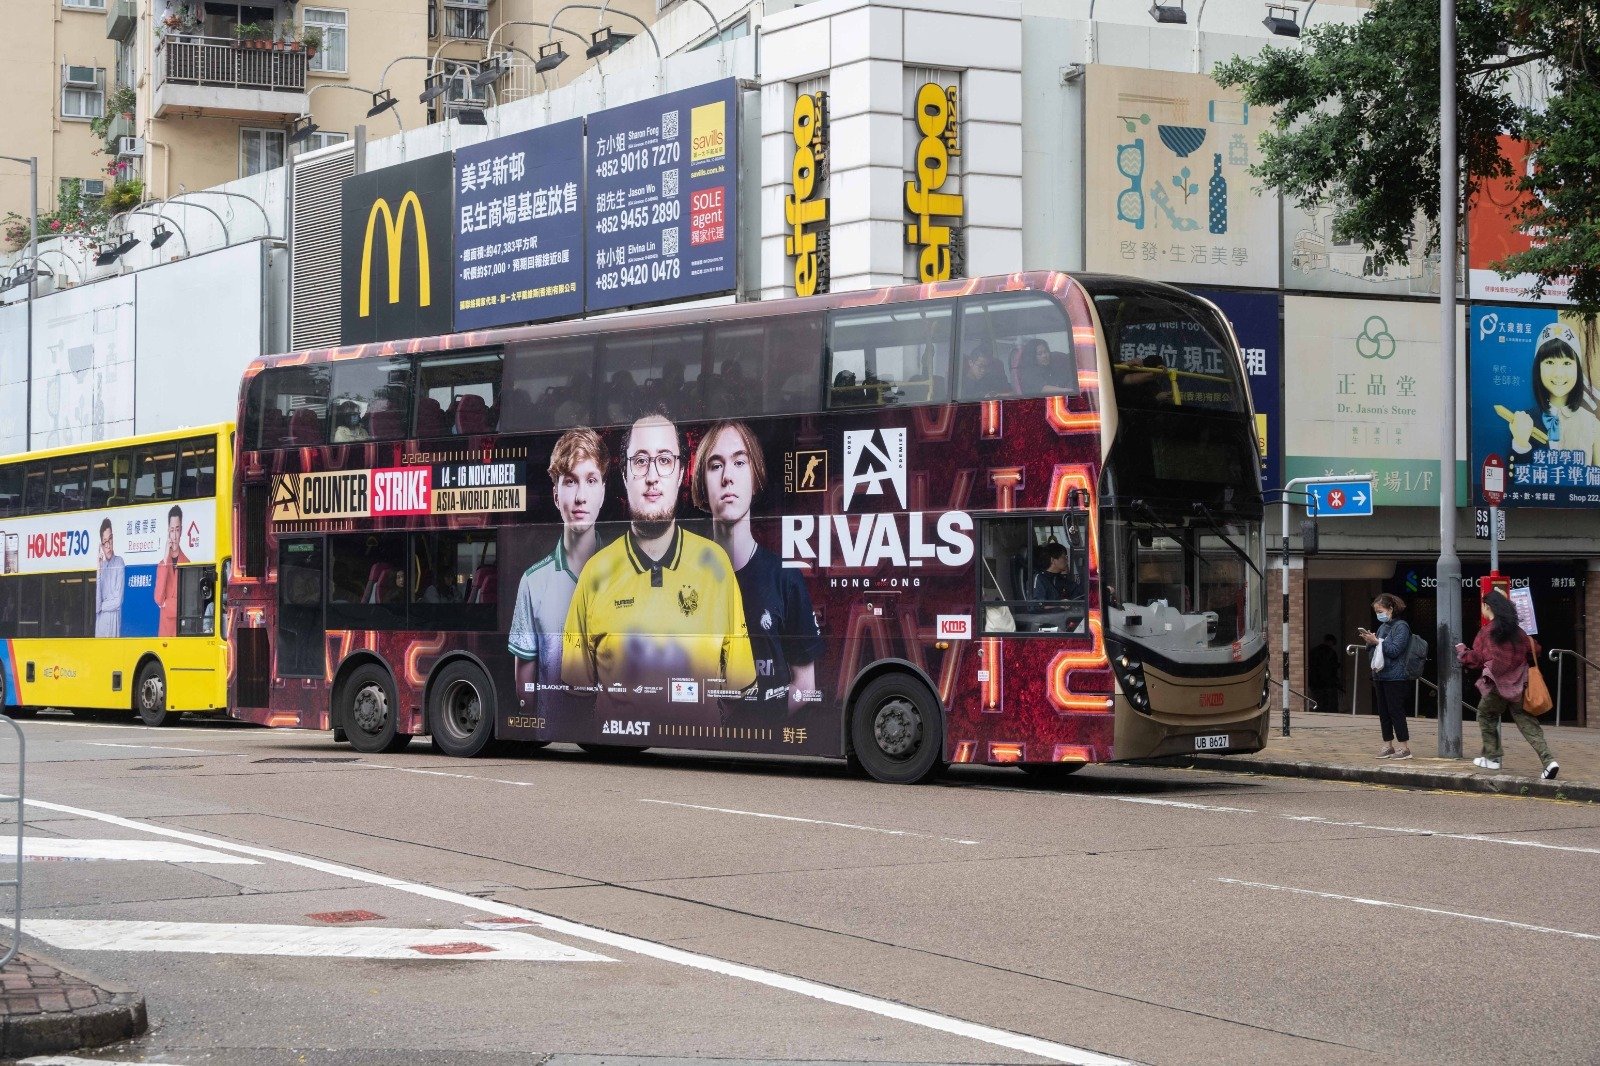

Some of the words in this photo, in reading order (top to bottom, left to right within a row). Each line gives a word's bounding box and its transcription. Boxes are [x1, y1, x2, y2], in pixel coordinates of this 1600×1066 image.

[628, 130, 646, 141] Sharon
[646, 126, 660, 137] Fong
[693, 132, 724, 150] savills
[596, 133, 626, 157] 方小姐
[596, 158, 619, 178] +852
[620, 148, 649, 174] 9018
[651, 141, 680, 167] 7270
[460, 151, 526, 194] 美孚新邨
[690, 165, 725, 179] savills.com.hk
[596, 189, 626, 214] 胡先生
[628, 187, 646, 198] Jason
[693, 190, 722, 211] SOLE
[460, 181, 578, 235] 民生商場基座放售
[596, 215, 619, 234] +852
[620, 205, 649, 231] 9455
[651, 199, 680, 225] 2890
[692, 208, 723, 229] agent
[646, 241, 656, 252] Lin
[596, 246, 626, 270] 林小姐
[596, 271, 619, 291] +852
[620, 263, 649, 288] 9420
[651, 257, 680, 283] 0478
[1335, 373, 1417, 397] 正品堂
[1337, 403, 1354, 414] Dr.
[1356, 403, 1389, 415] Jason's
[1391, 405, 1417, 416] Store
[1533, 449, 1585, 465] 疫情學期
[441, 467, 451, 488] 14
[457, 466, 467, 486] 16
[468, 463, 516, 486] NOVEMBER
[1514, 464, 1600, 486] 要兩手準備
[303, 473, 368, 515] COUNTER
[374, 469, 428, 513] STRIKE
[436, 490, 490, 513] ASIA-WORLD
[491, 488, 521, 510] ARENA
[1569, 494, 1587, 503] Shop
[1476, 510, 1489, 522] SS
[782, 510, 975, 568] RIVALS
[1476, 524, 1489, 537] 319
[27, 529, 90, 559] HOUSE730
[128, 540, 154, 551] Respect
[830, 578, 871, 588] HONG
[881, 577, 921, 588] ONG
[941, 620, 967, 634] KMB
[610, 720, 651, 736] BLAST
[782, 727, 808, 745] 對手
[1195, 737, 1207, 749] UB
[1209, 736, 1228, 748] 8627
